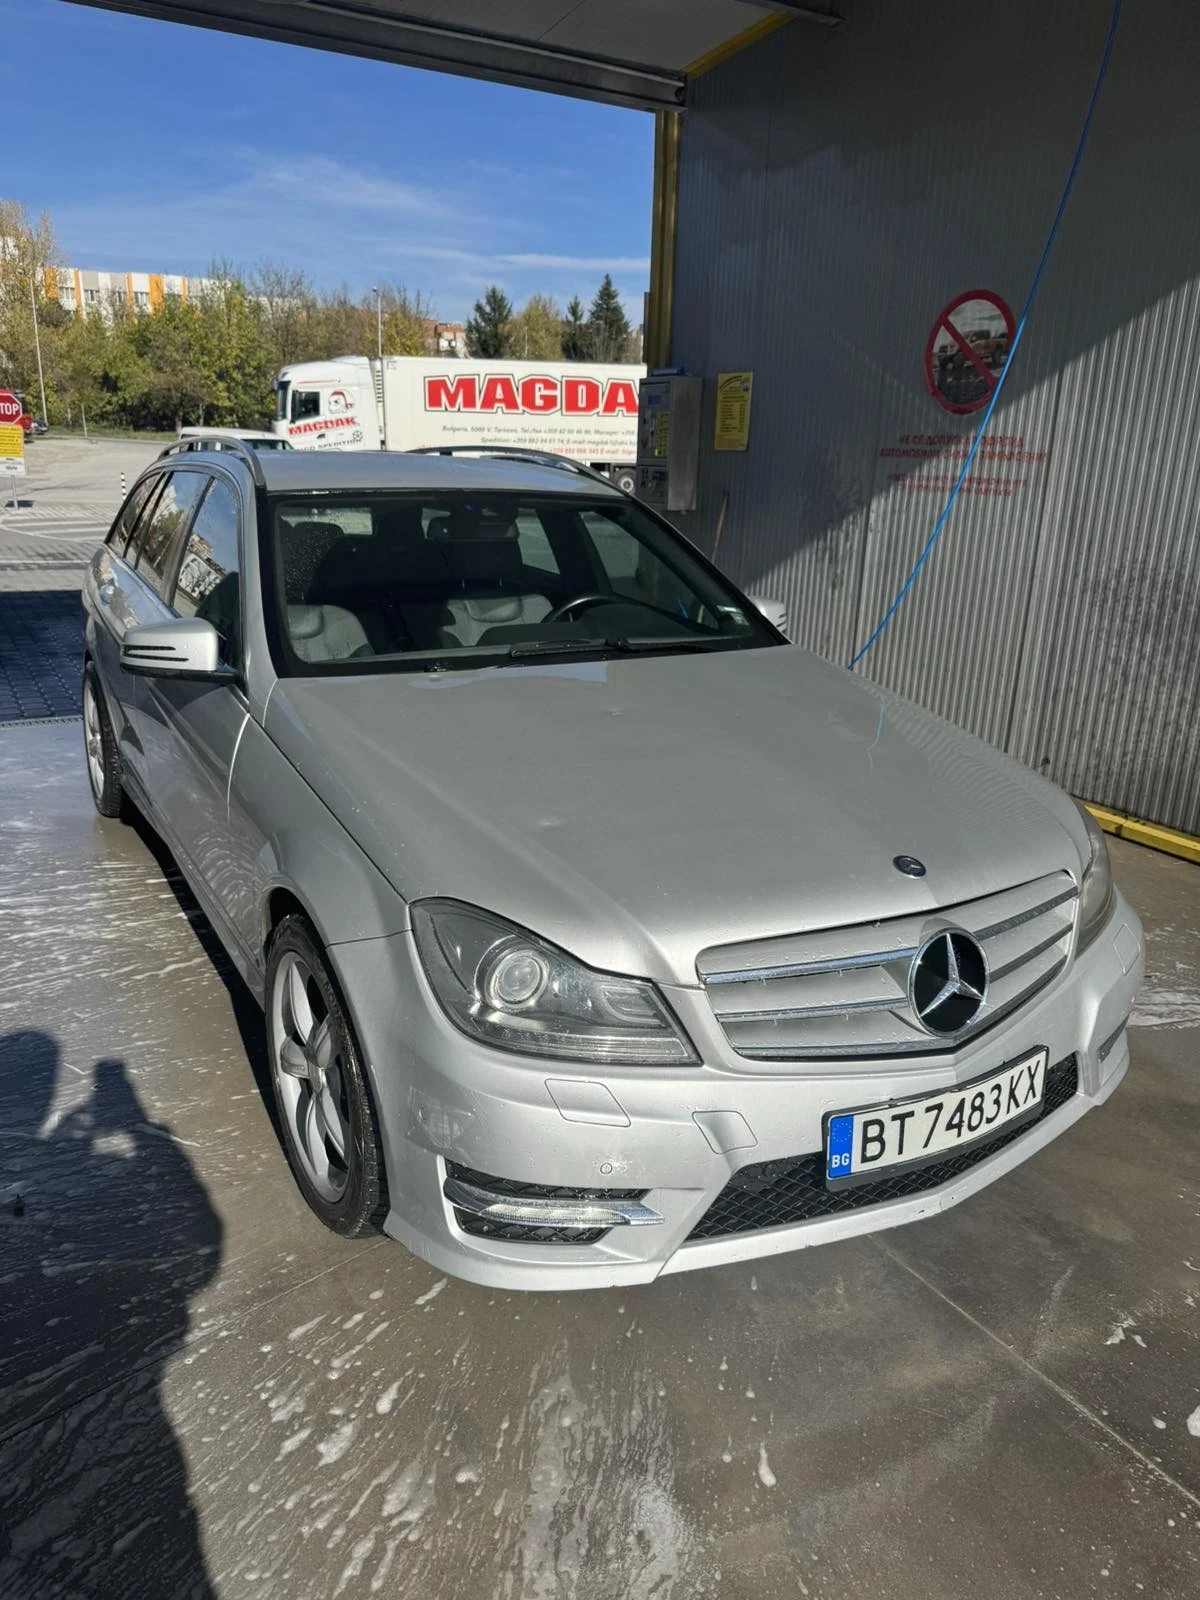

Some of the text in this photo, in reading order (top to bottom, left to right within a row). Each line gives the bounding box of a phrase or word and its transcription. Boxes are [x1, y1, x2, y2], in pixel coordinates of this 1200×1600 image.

[424, 374, 639, 416] MAGDA
[0, 402, 19, 415] TOP
[288, 416, 357, 436] MAGDAK
[832, 1153, 850, 1168] BG
